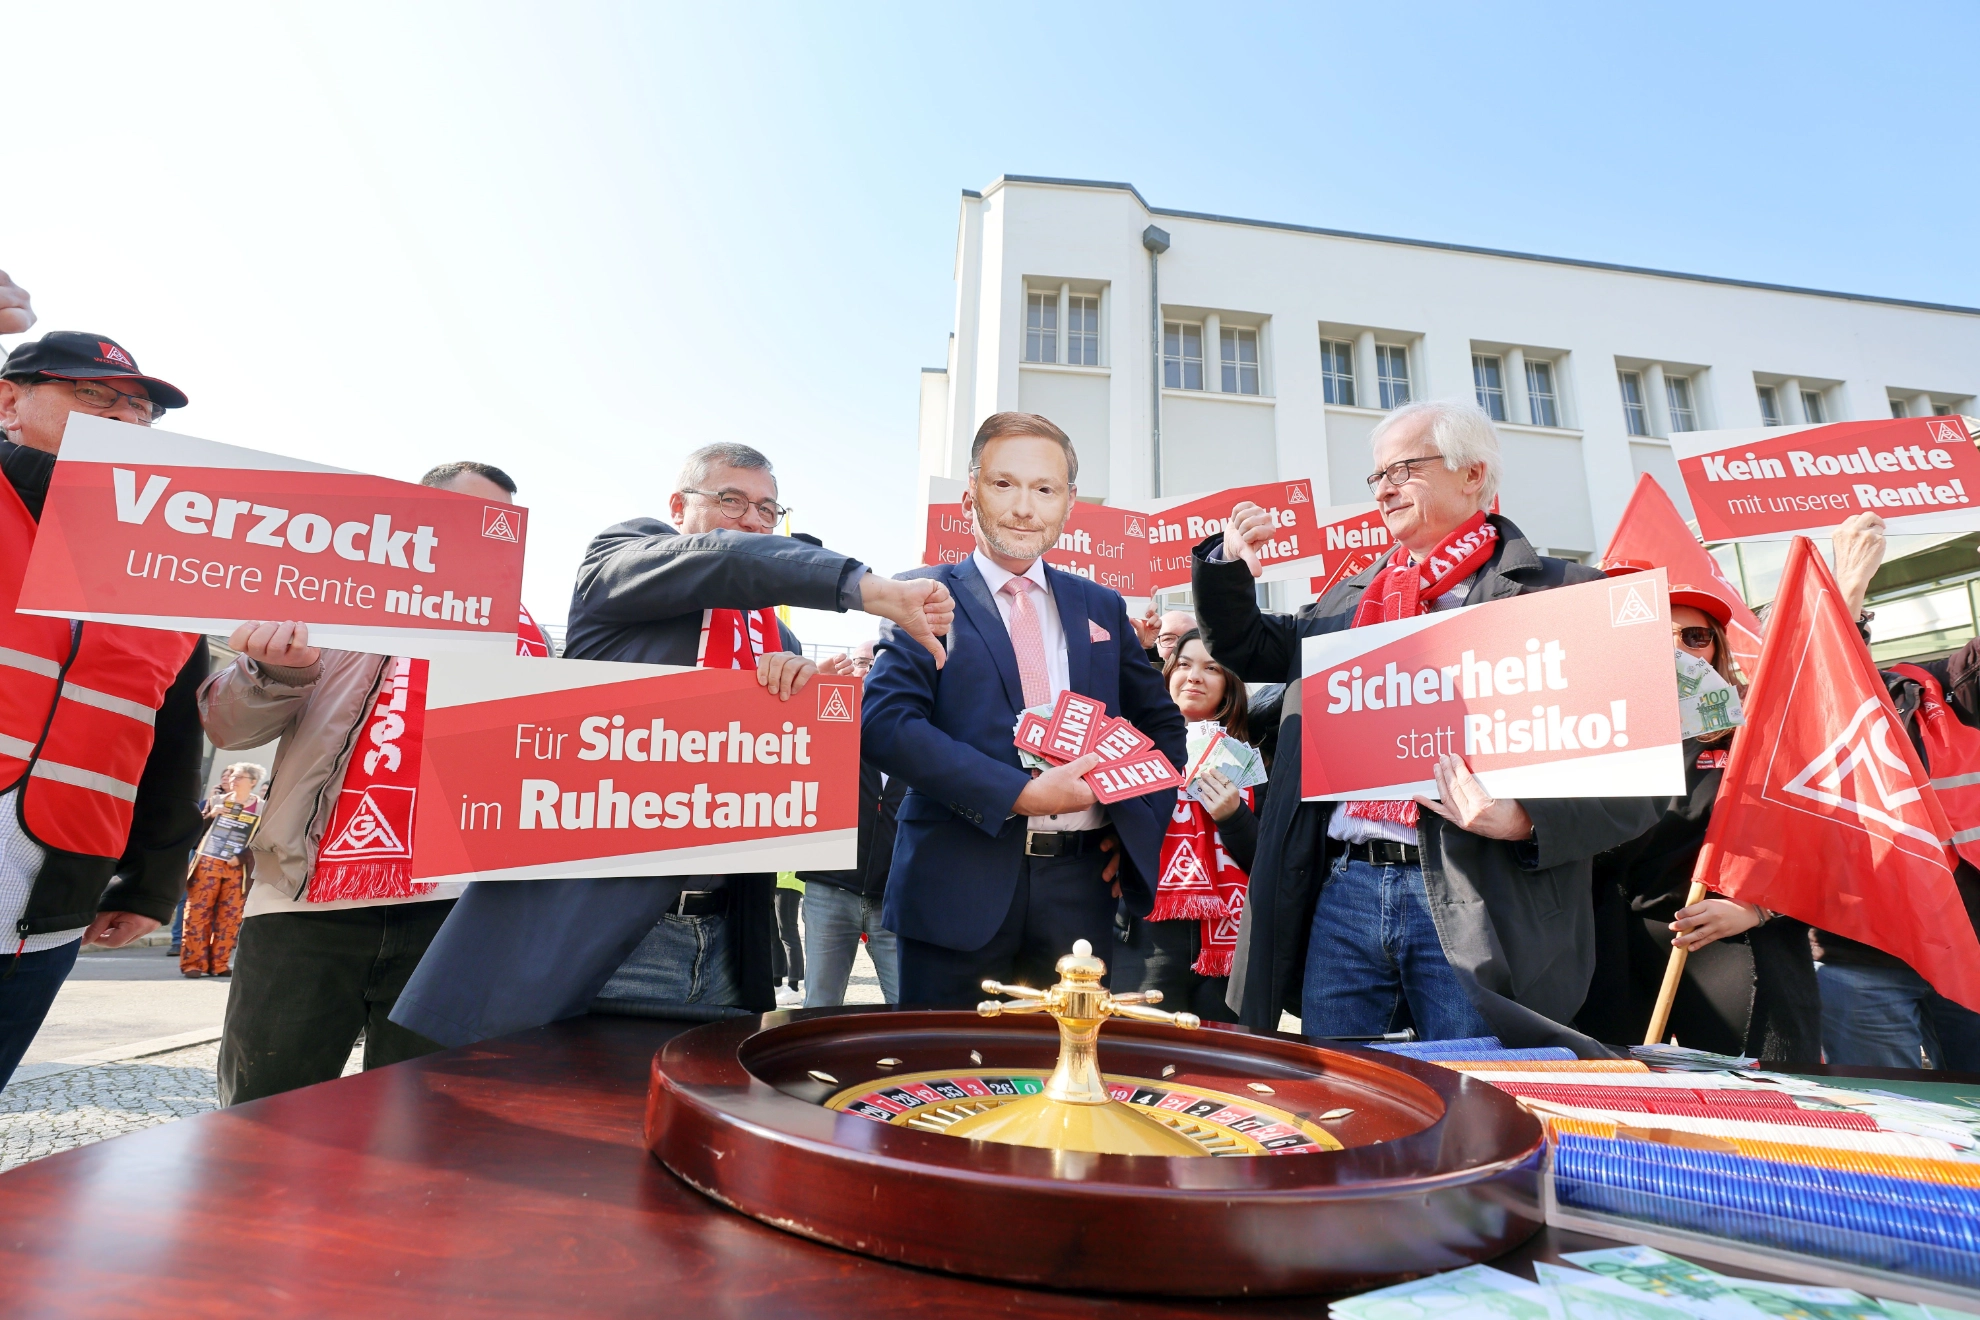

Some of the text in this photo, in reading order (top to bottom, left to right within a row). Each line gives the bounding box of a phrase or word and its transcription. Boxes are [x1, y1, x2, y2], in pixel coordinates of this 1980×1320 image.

[1701, 445, 1955, 482] Kein Roulette
[1727, 478, 1969, 515] mit unserer Rente!
[112, 467, 438, 573] Verzockt
[1326, 521, 1388, 551] Nein
[1096, 540, 1125, 559] darf
[126, 550, 493, 626] unsere Rente nicht!
[1101, 570, 1135, 590] sein!
[1326, 637, 1568, 715] Sicherheit
[1703, 688, 1730, 706] 100
[1054, 698, 1094, 756] RENTE
[1396, 699, 1629, 760] statt Risiko!
[515, 714, 811, 765] Für Sicherheit
[1093, 759, 1172, 794] RENTE
[460, 778, 819, 830] im Ruhestand!
[915, 1088, 942, 1103] 12
[936, 1085, 965, 1099] 35
[967, 1083, 985, 1096] 3
[989, 1083, 1013, 1095] 26
[1024, 1083, 1038, 1094] 0
[1136, 1094, 1153, 1105] 4
[1161, 1098, 1184, 1111] 21
[1189, 1105, 1211, 1116] 2
[1211, 1110, 1240, 1123] 25
